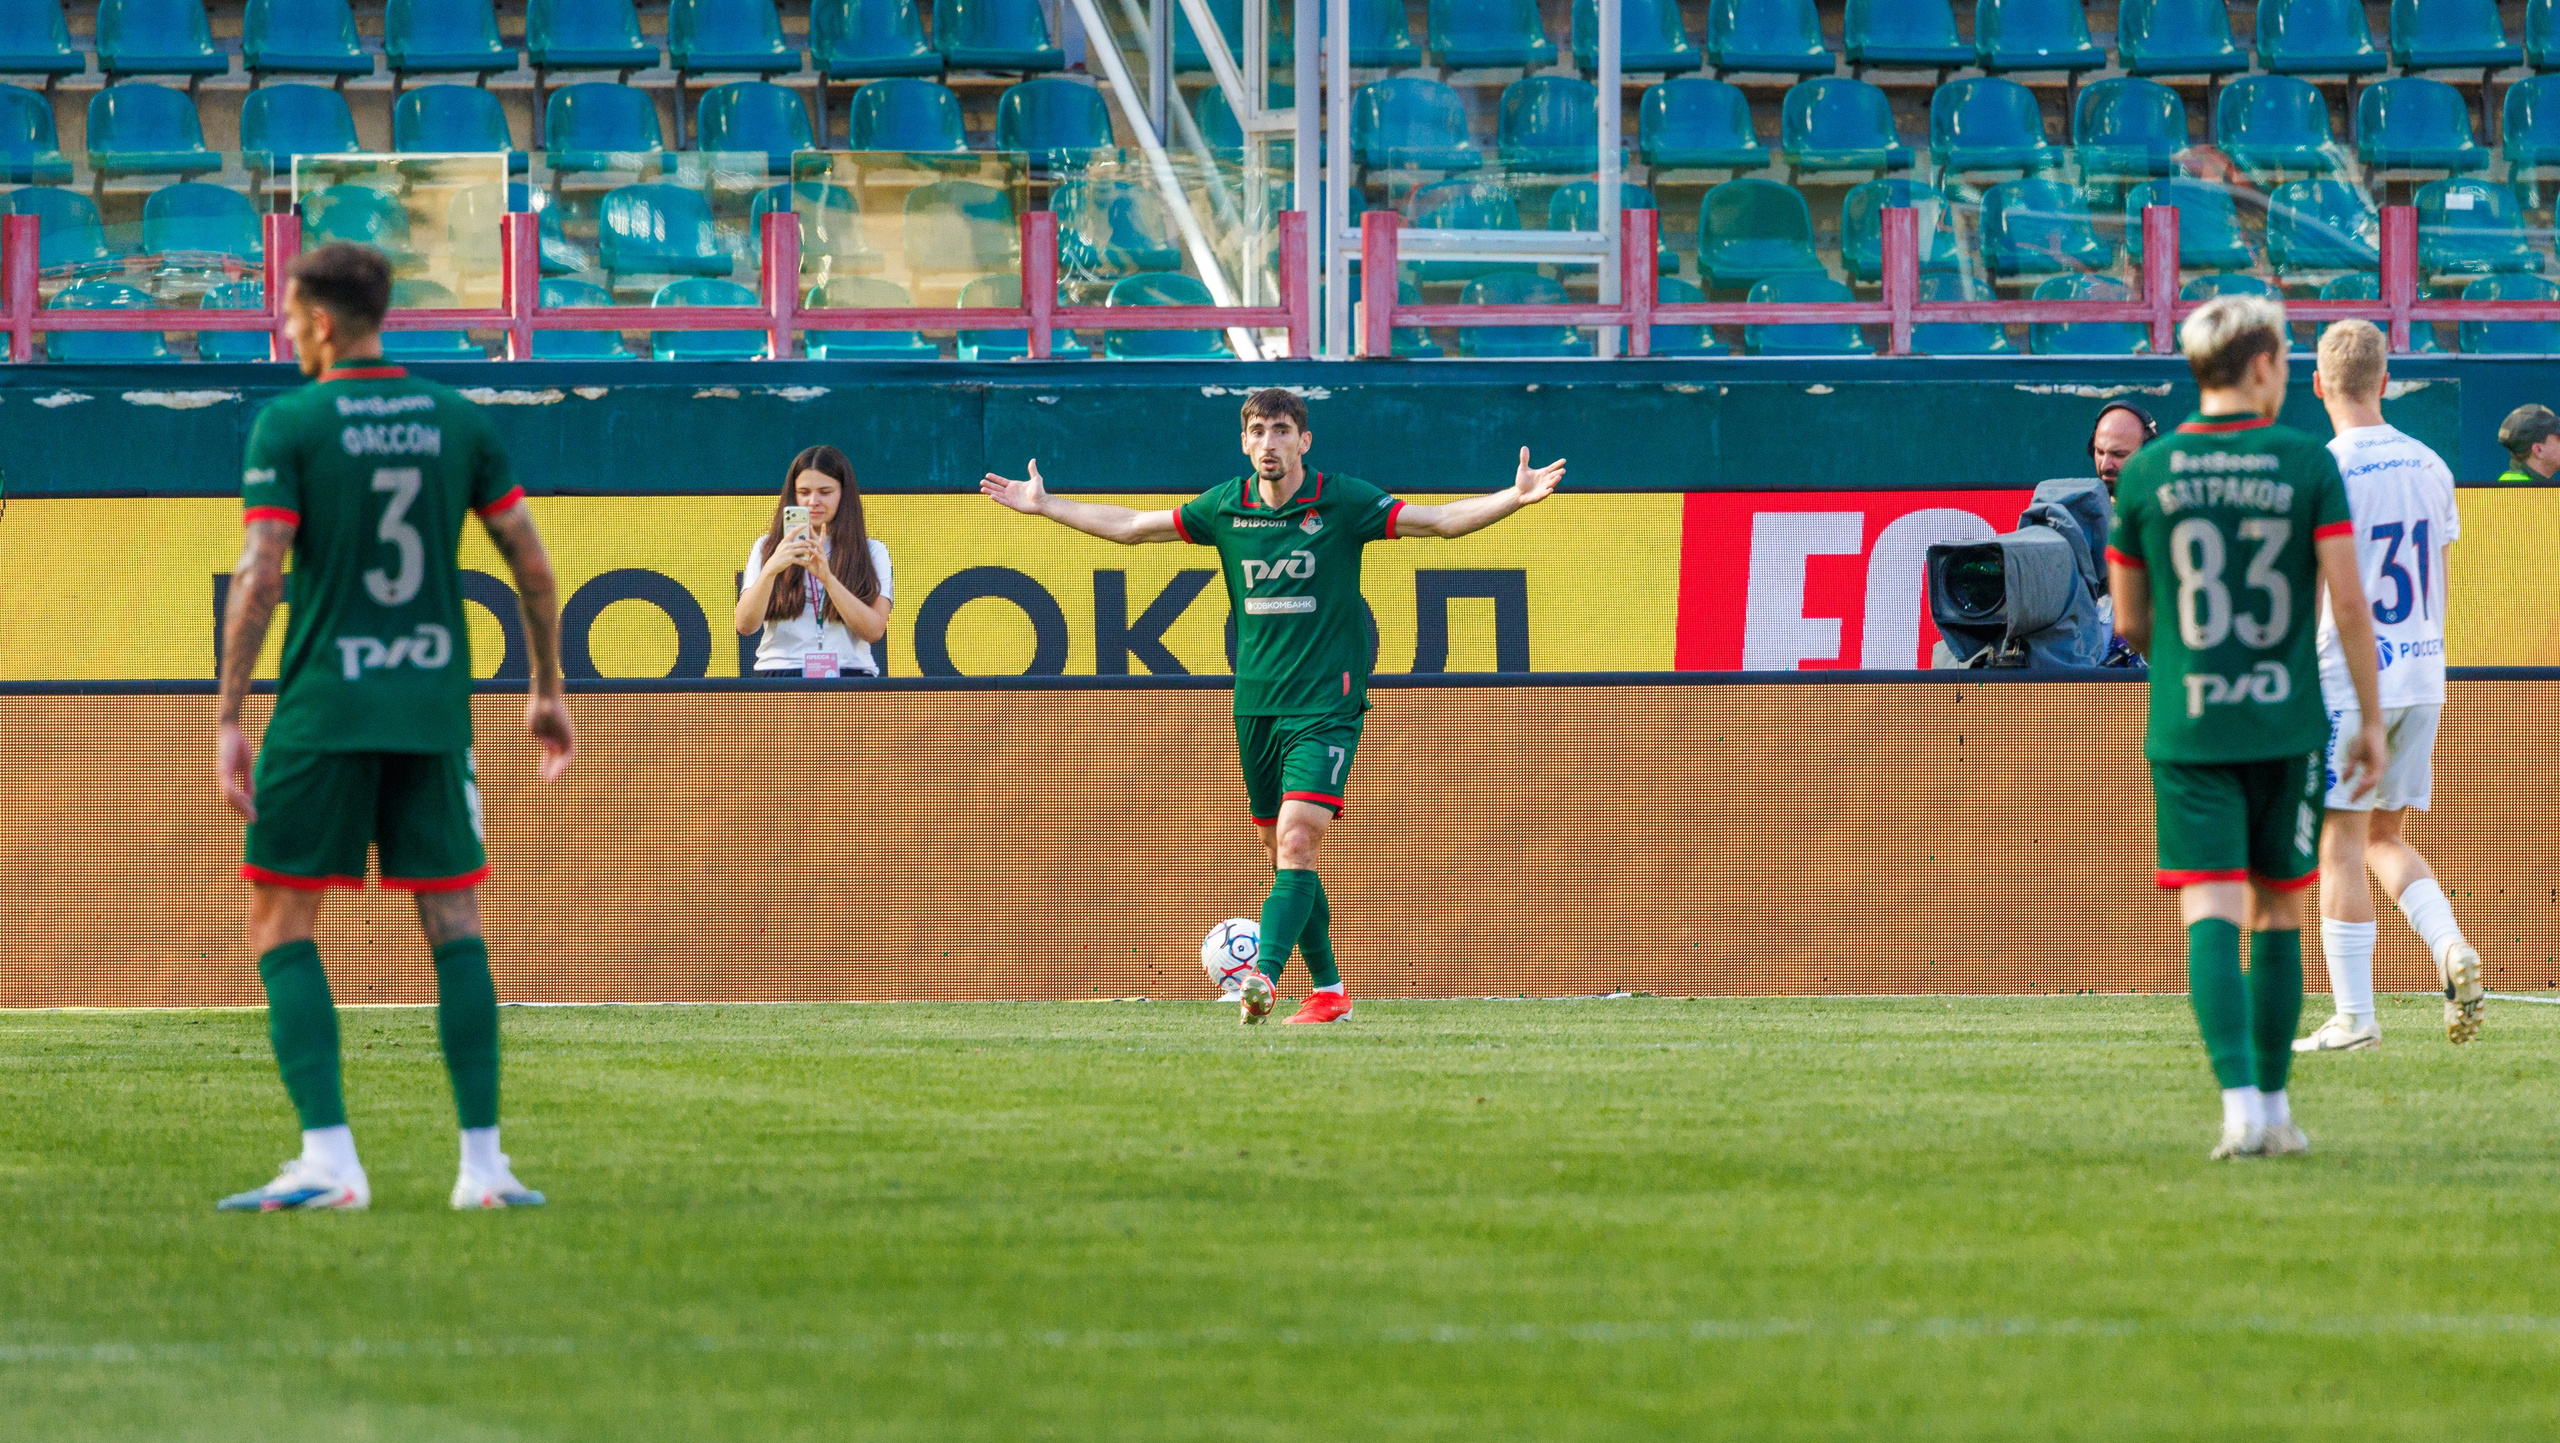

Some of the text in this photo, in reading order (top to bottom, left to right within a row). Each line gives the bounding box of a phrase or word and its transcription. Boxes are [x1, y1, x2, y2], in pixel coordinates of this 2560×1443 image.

[2170, 450, 2279, 473] BetBoom
[363, 467, 425, 607] 3
[1232, 516, 1287, 528] BetBoom
[2170, 517, 2293, 650] 83
[2371, 519, 2429, 625] 31
[1328, 745, 1345, 785] 7
